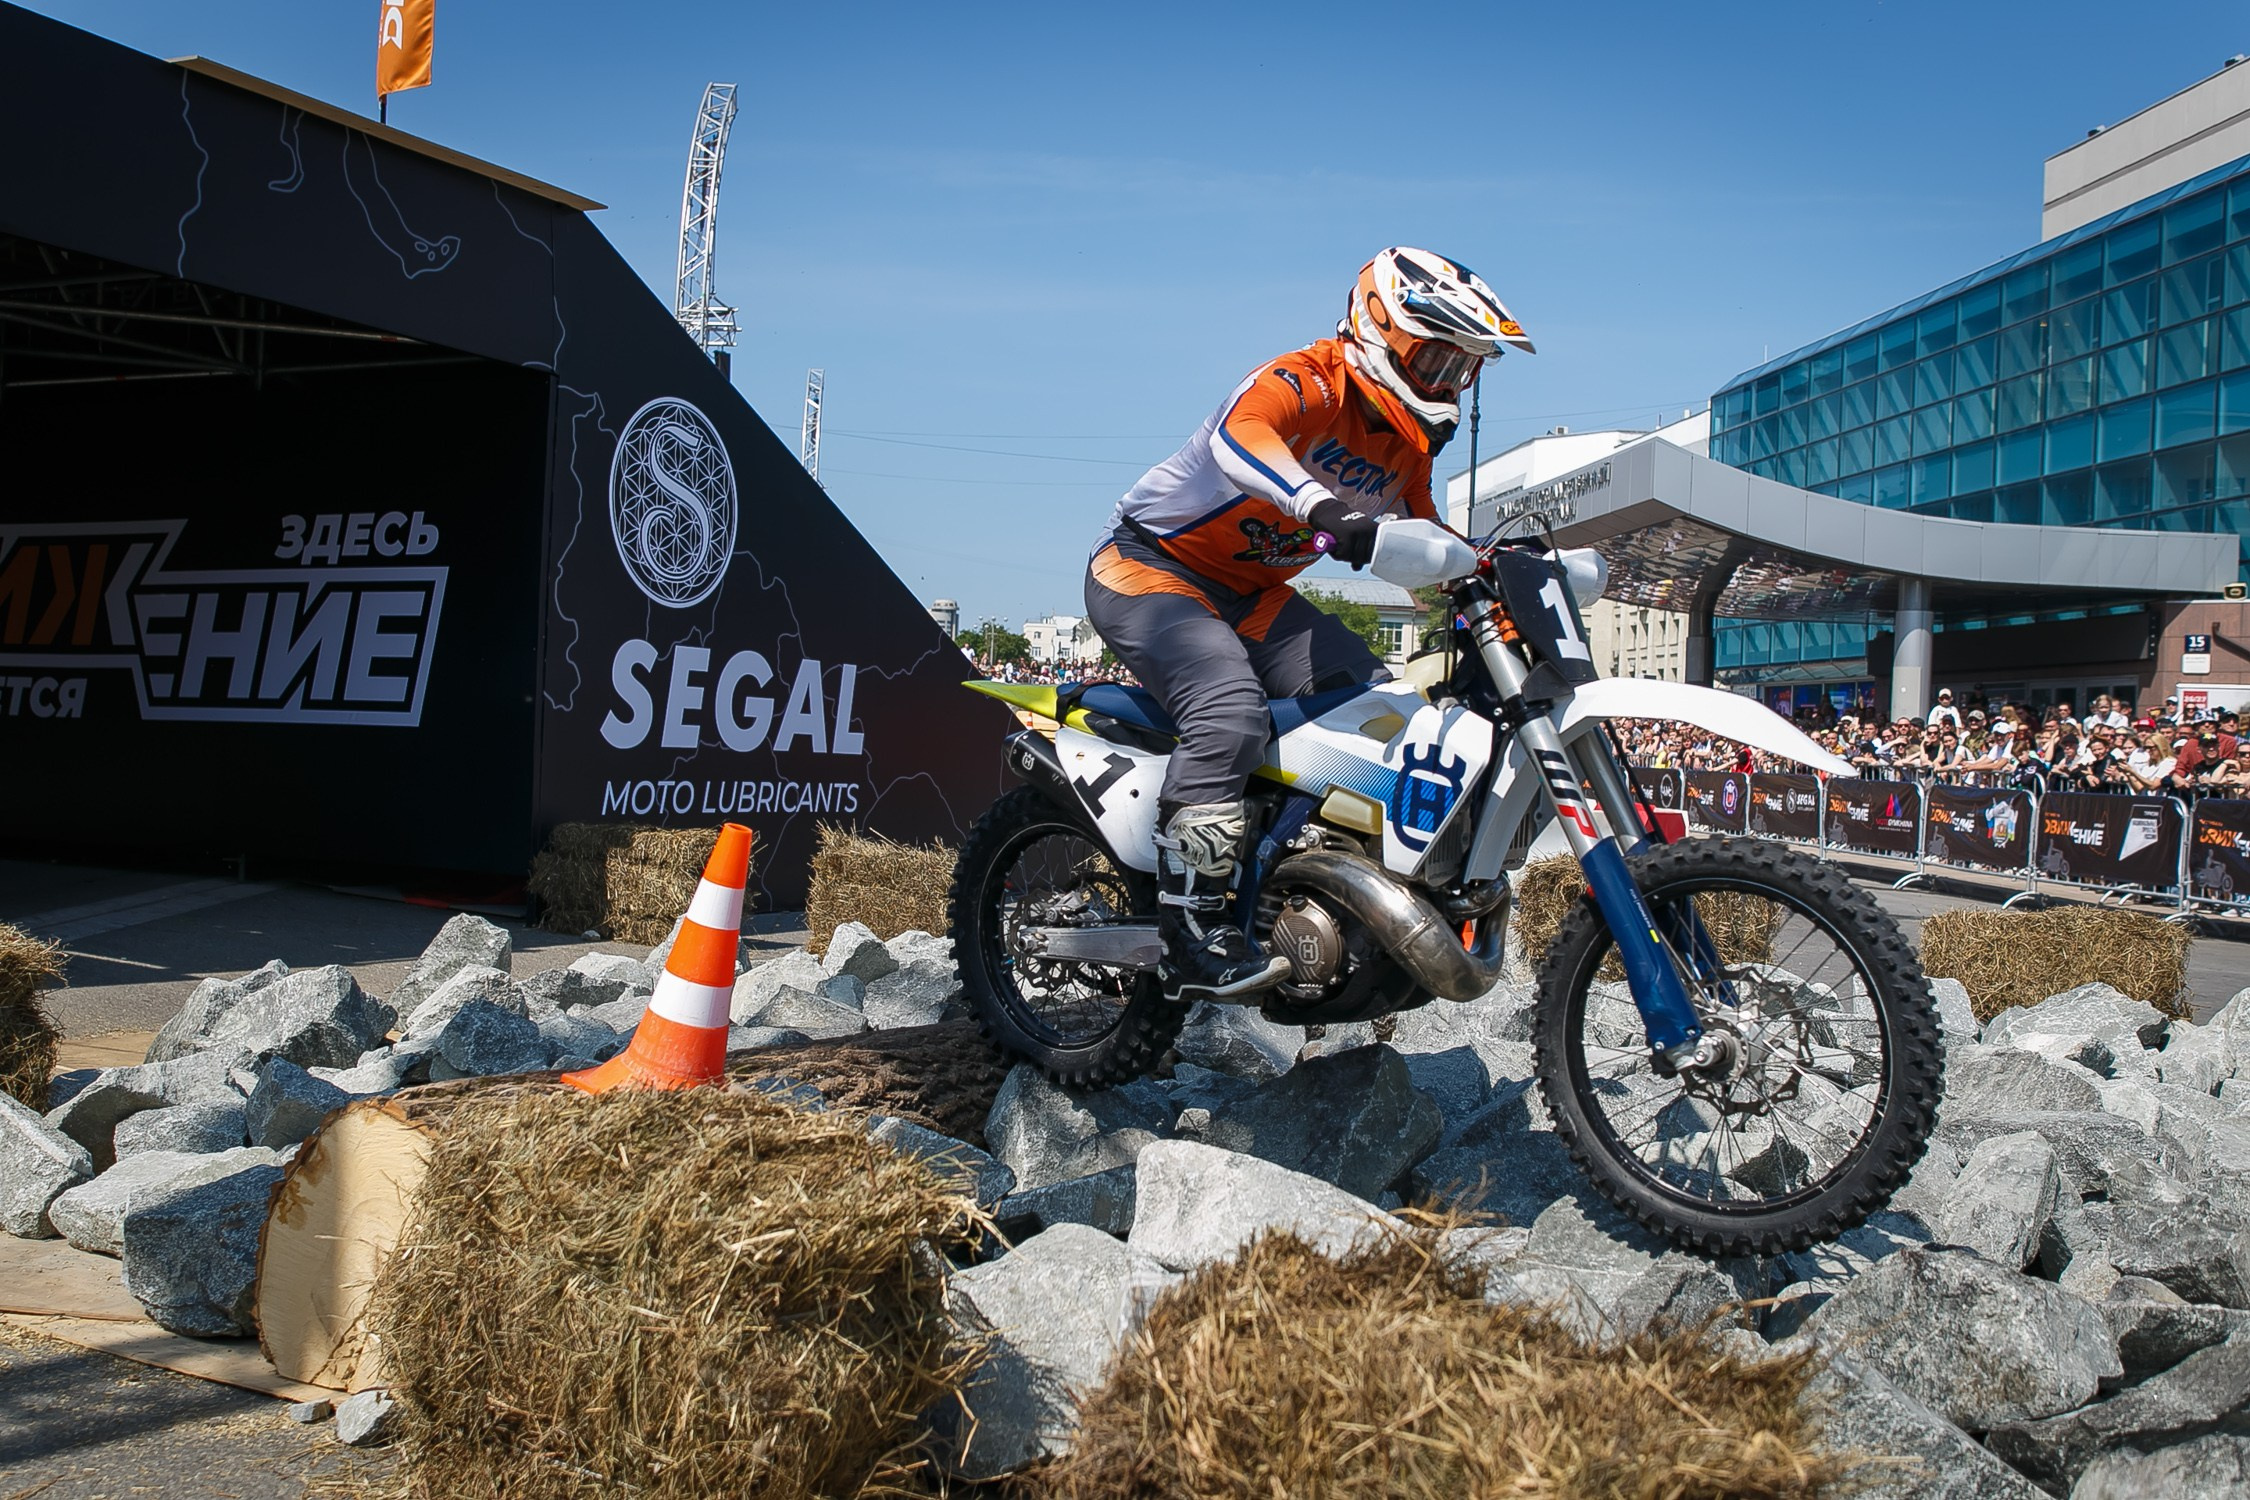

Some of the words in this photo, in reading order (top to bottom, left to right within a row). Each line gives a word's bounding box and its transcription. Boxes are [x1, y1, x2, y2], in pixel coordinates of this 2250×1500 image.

[275, 511, 439, 565] ЗДЕСЬ
[1538, 577, 1592, 663] 1
[2188, 636, 2206, 648] 15
[0, 676, 88, 719] ТСЯ
[600, 639, 865, 755] SEGAL
[601, 780, 695, 816] MOTO
[702, 781, 859, 815] LUBRICANTS
[1073, 752, 1136, 821] 1
